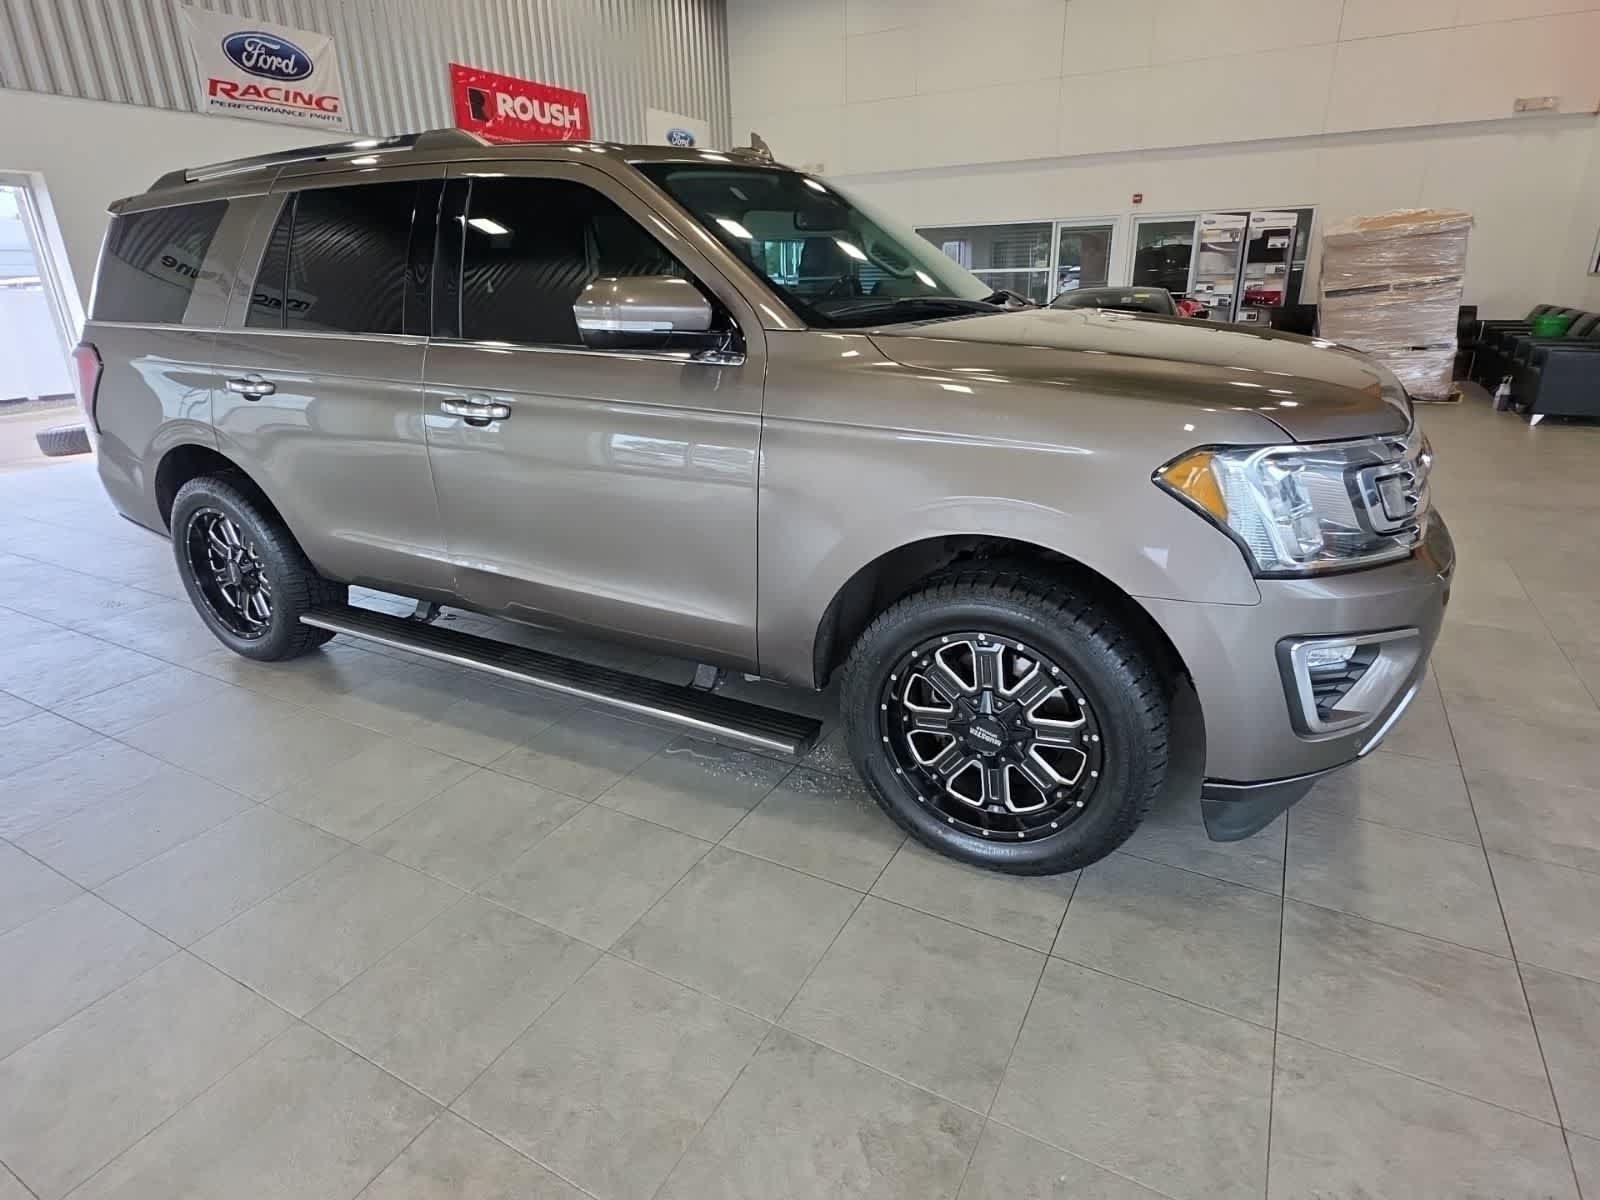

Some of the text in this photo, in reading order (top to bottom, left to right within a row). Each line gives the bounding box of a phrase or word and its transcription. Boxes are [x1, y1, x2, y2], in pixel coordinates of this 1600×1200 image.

[242, 38, 297, 73] Ford
[208, 78, 339, 113] RACING
[210, 99, 342, 123] PERFORMANCE PARTS
[496, 92, 580, 129] ROUSH
[671, 131, 690, 148] Ford
